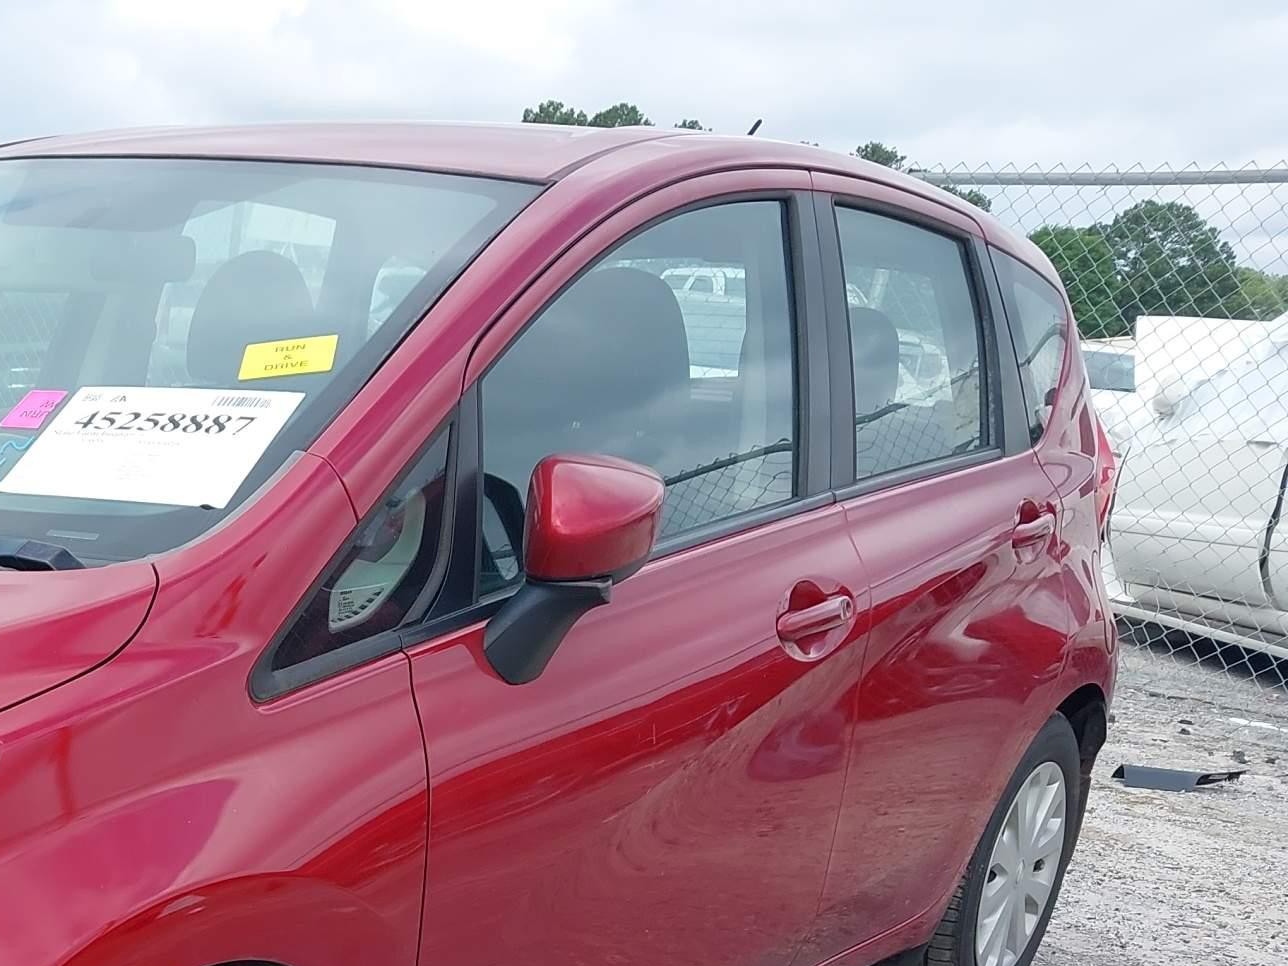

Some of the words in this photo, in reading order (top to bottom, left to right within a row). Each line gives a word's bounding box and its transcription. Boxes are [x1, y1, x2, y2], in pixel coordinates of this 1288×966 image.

[275, 344, 306, 352] RUN
[264, 360, 310, 371] DRIVE
[74, 410, 258, 436] 45258887
